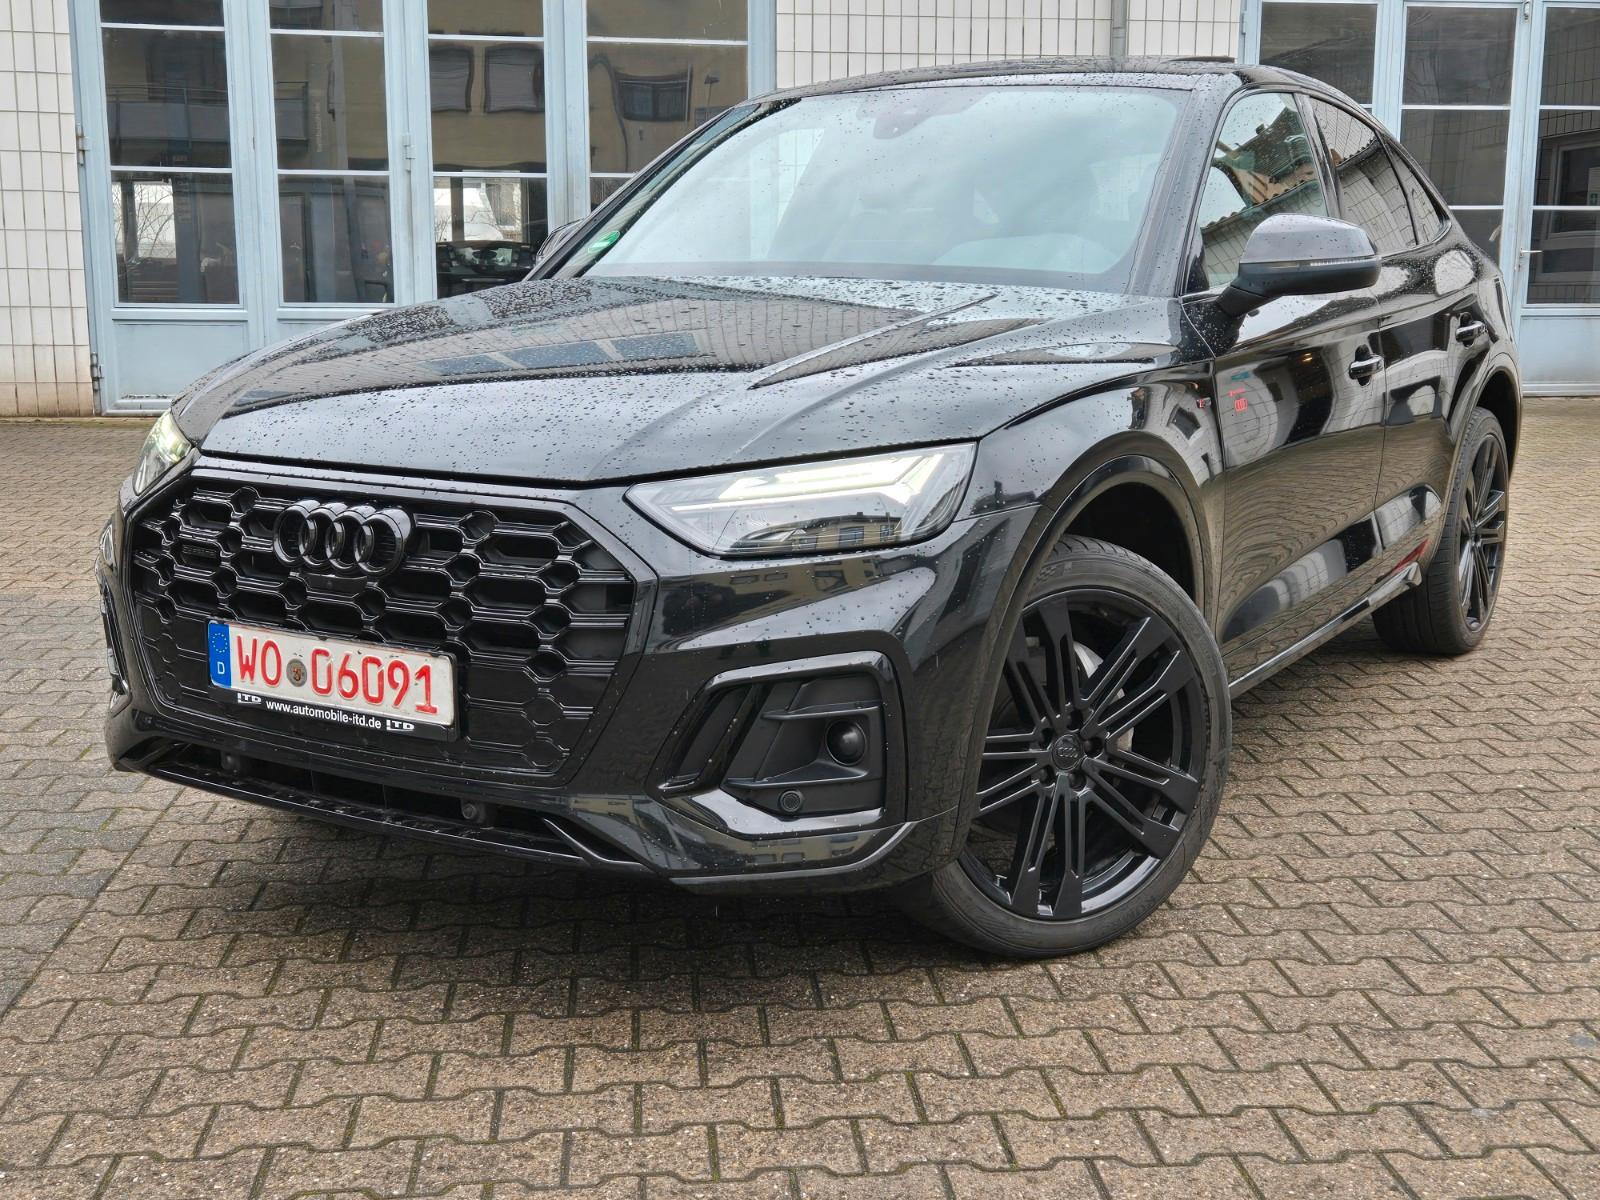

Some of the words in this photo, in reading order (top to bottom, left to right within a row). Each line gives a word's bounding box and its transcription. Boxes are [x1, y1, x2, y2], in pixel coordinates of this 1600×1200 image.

[217, 661, 225, 675] D
[237, 635, 282, 686] WO
[311, 648, 438, 714] 06091
[266, 701, 381, 729] www.automobile-itd.de
